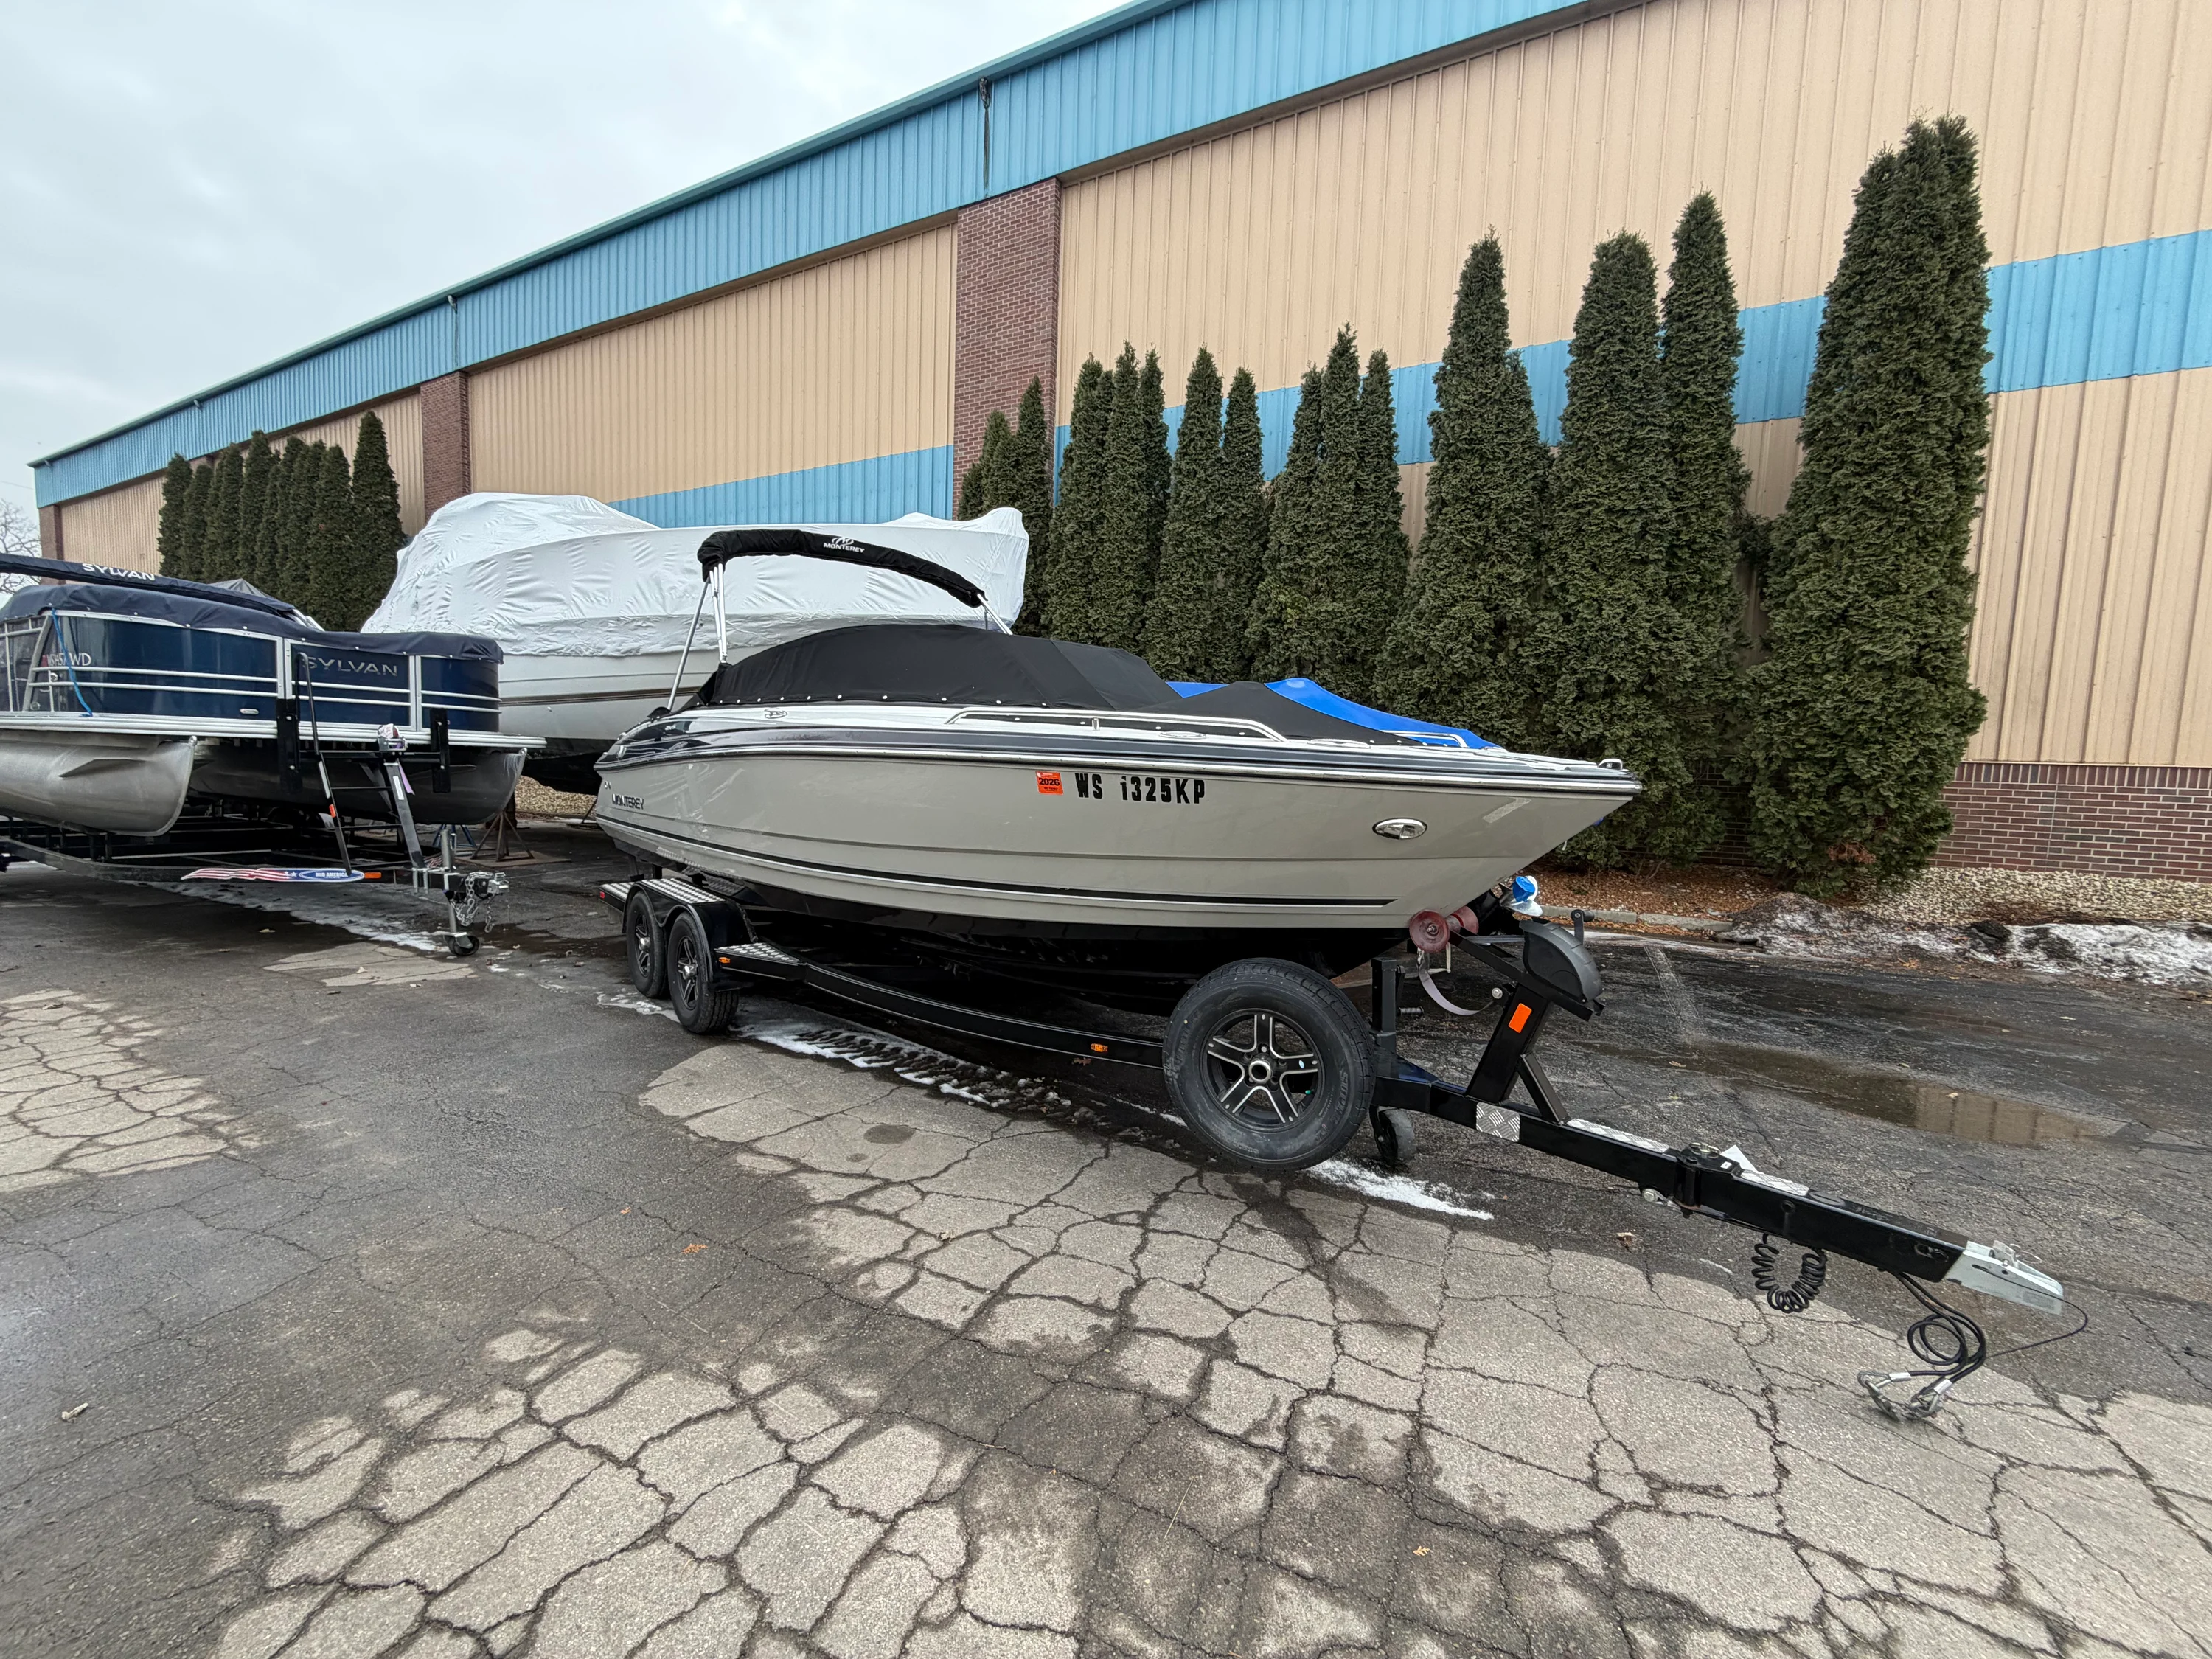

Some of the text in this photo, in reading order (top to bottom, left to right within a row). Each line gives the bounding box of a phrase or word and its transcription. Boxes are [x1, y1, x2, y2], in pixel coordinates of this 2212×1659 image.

[823, 542, 865, 553] MONTEREY
[82, 563, 156, 581] SYLVAN
[302, 656, 397, 676] SYLVAN
[1038, 777, 1060, 786] 2026
[1075, 773, 1103, 799] WS
